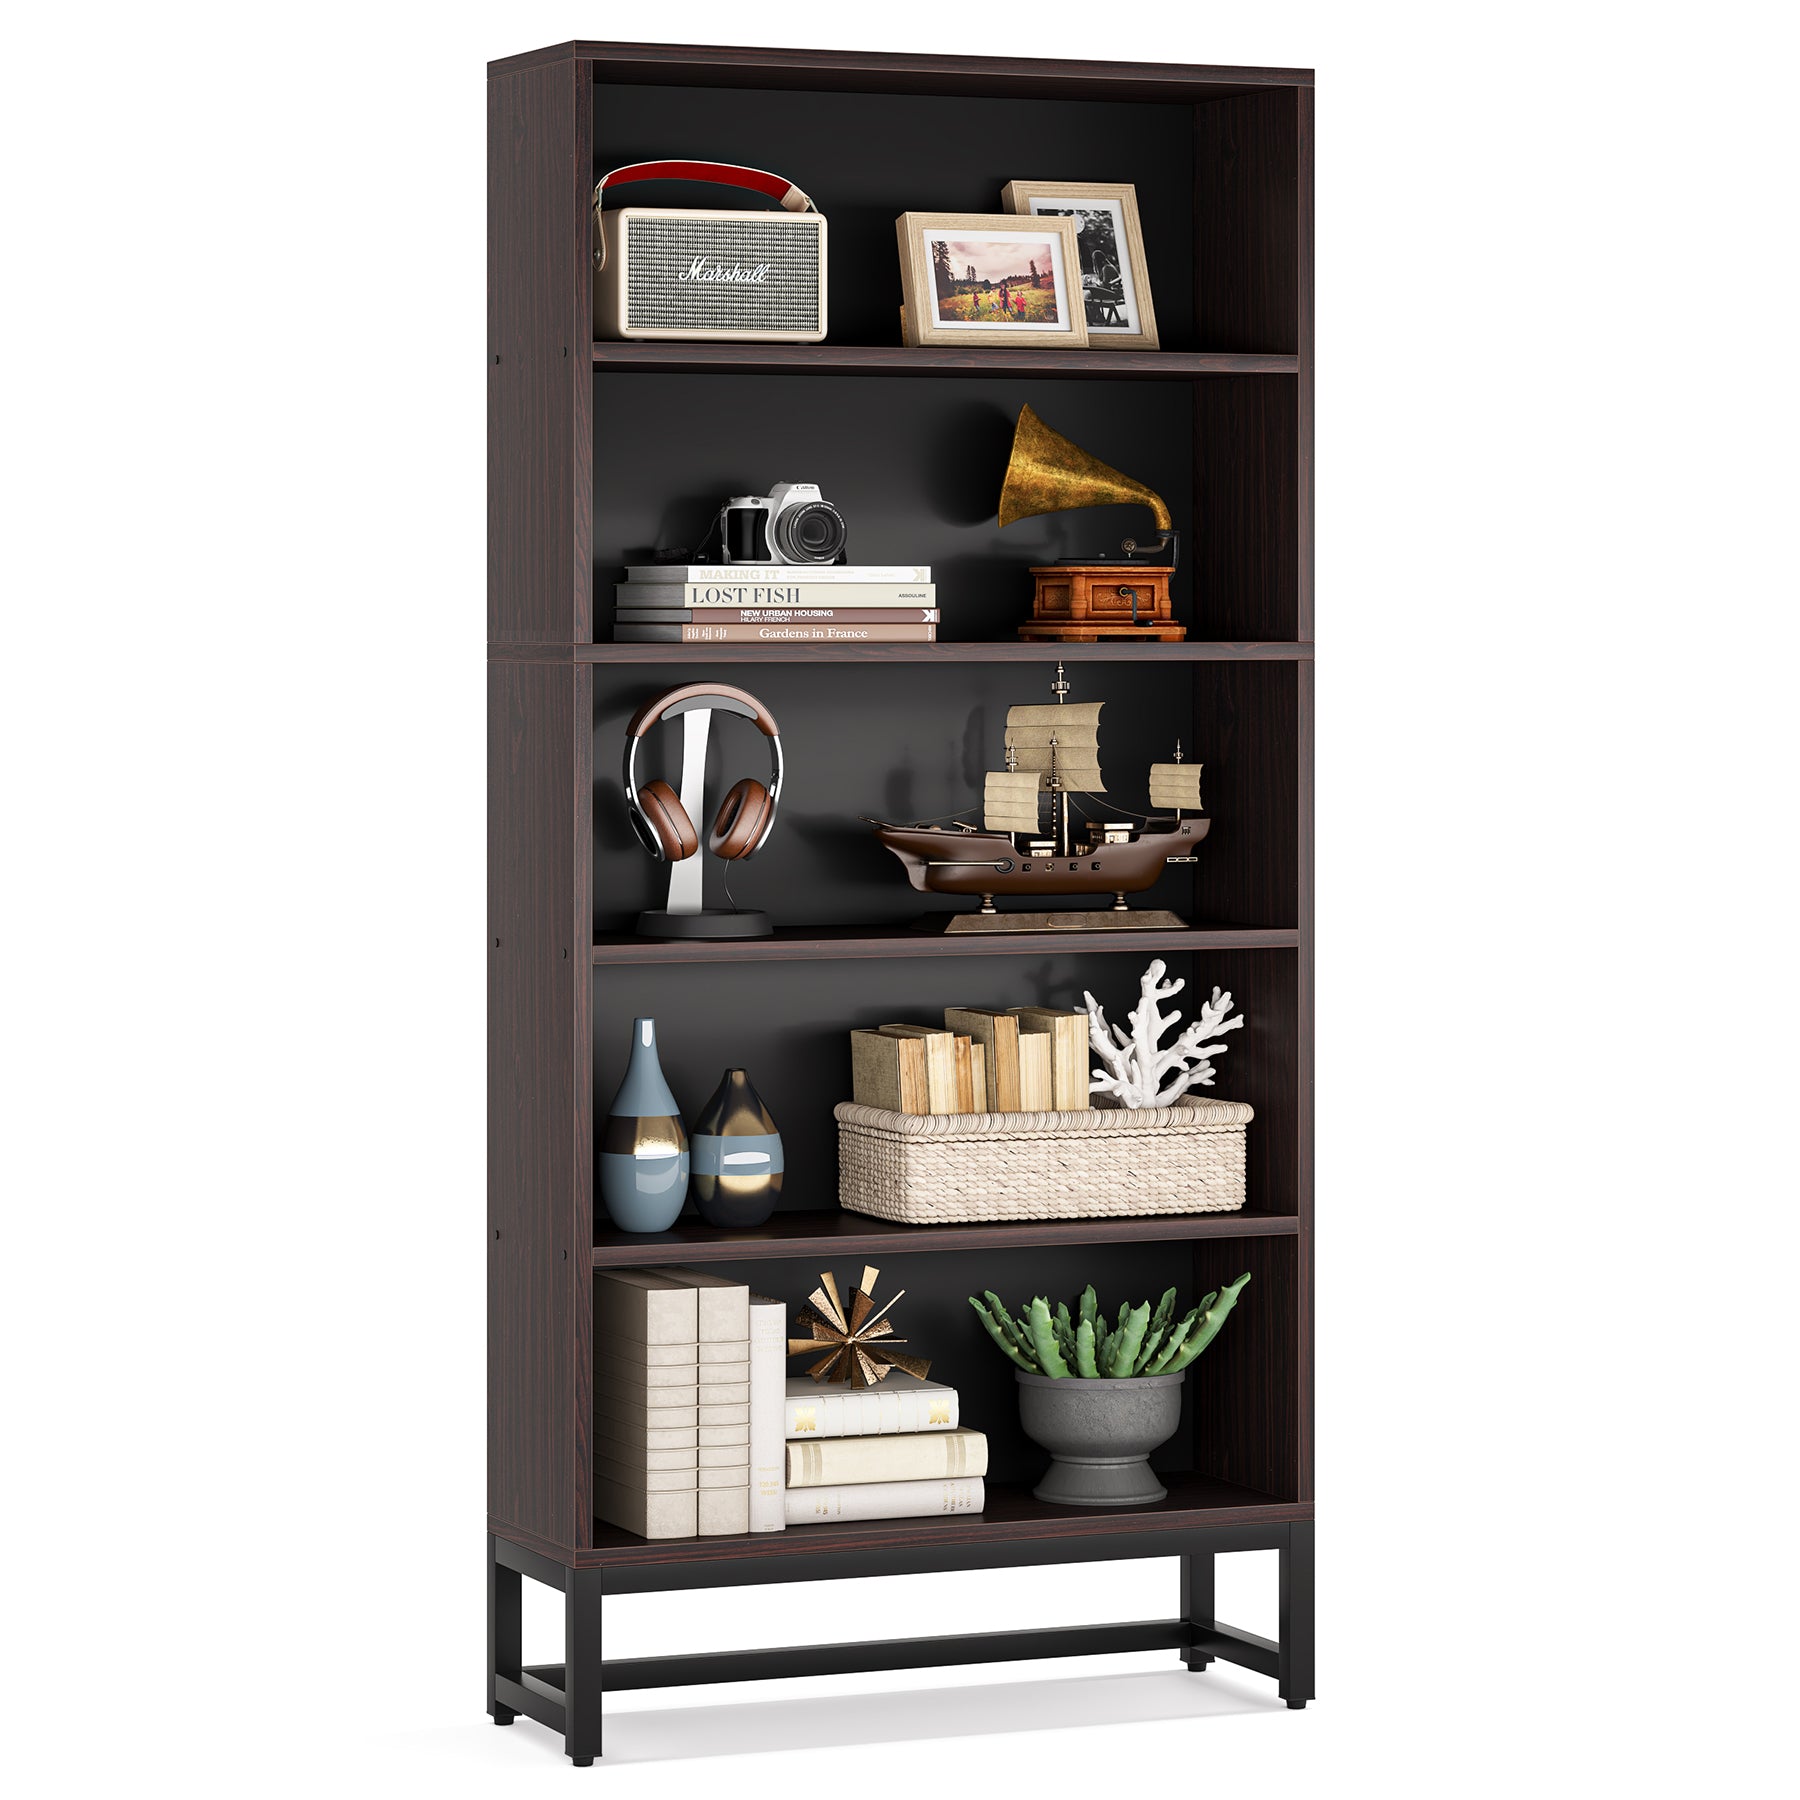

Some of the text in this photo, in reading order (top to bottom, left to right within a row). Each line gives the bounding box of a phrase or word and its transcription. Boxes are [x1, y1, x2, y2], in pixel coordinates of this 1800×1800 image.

[679, 256, 770, 282] Marshall
[700, 569, 780, 580] MAKING IT
[692, 587, 800, 603] LOST FISH
[759, 628, 868, 638] Gardens in France
